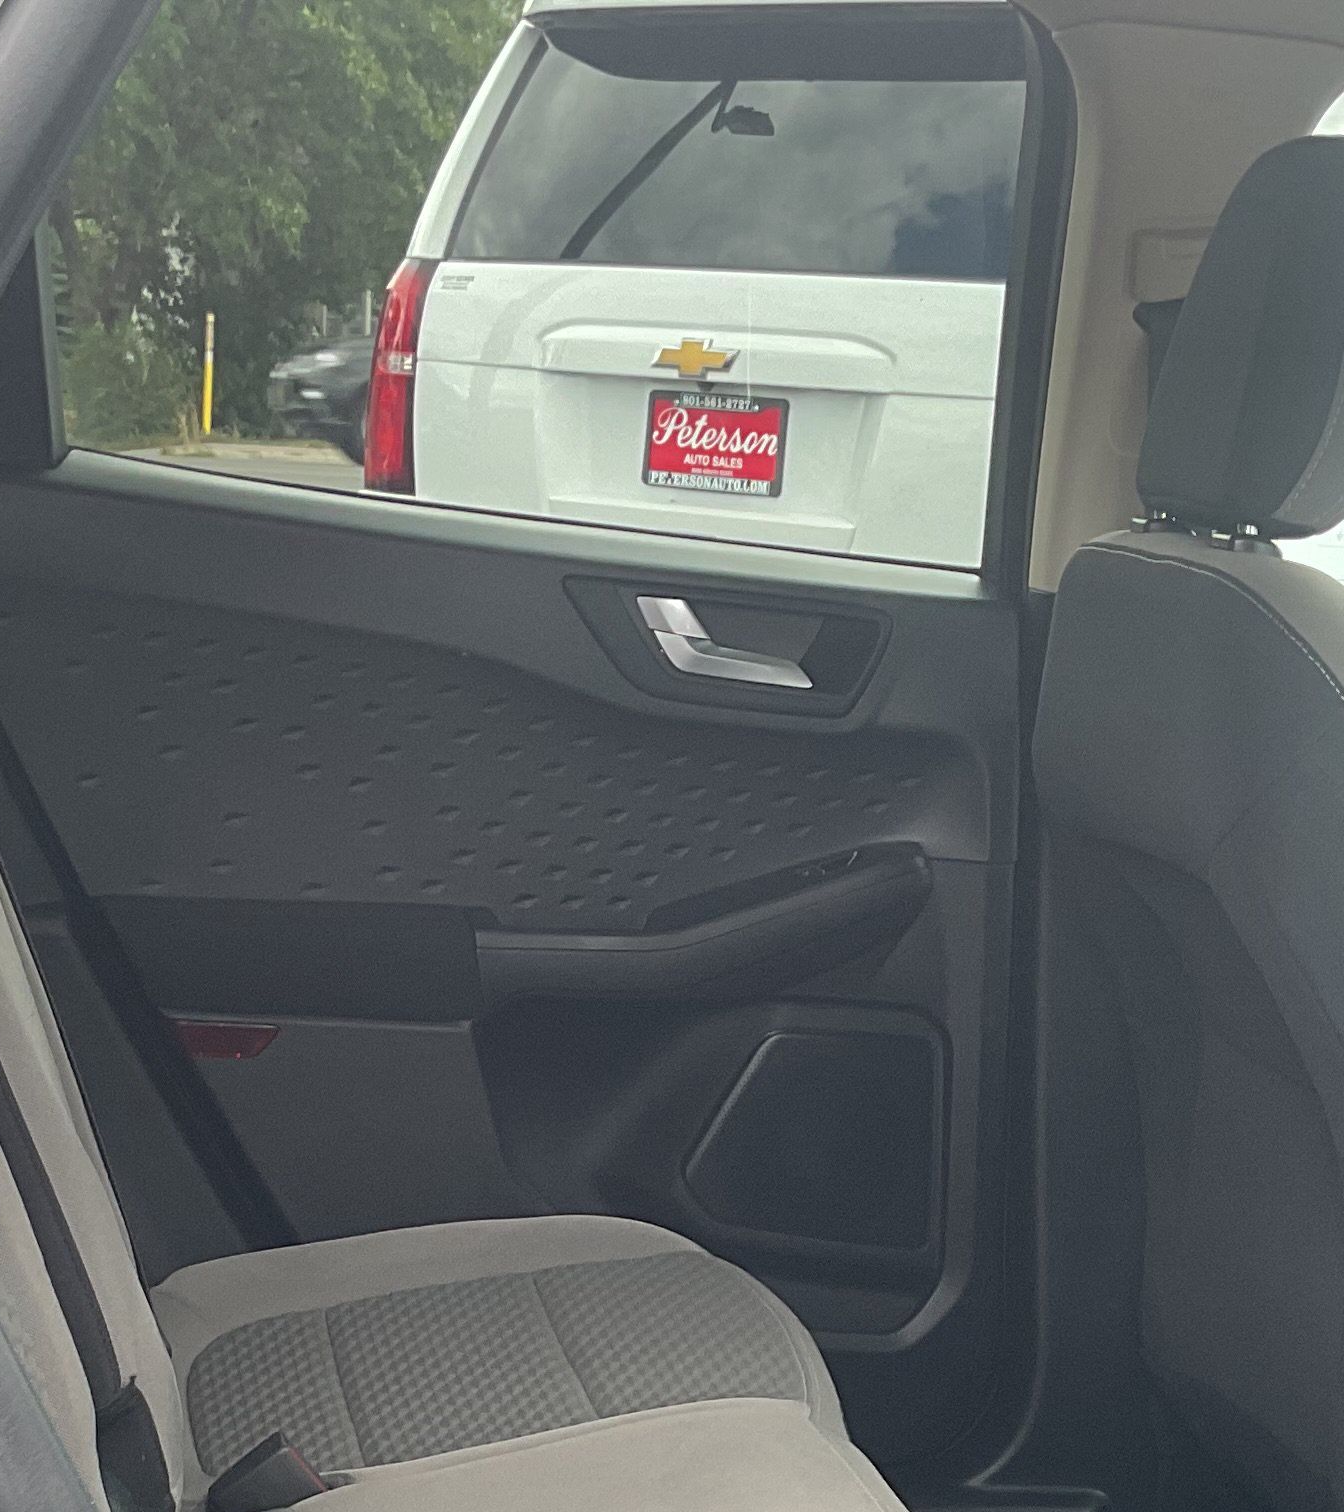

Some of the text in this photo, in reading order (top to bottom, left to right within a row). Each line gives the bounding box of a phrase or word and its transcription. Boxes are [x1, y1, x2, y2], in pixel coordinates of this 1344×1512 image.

[653, 407, 778, 456] Peterson
[683, 453, 743, 469] AUTO SALES
